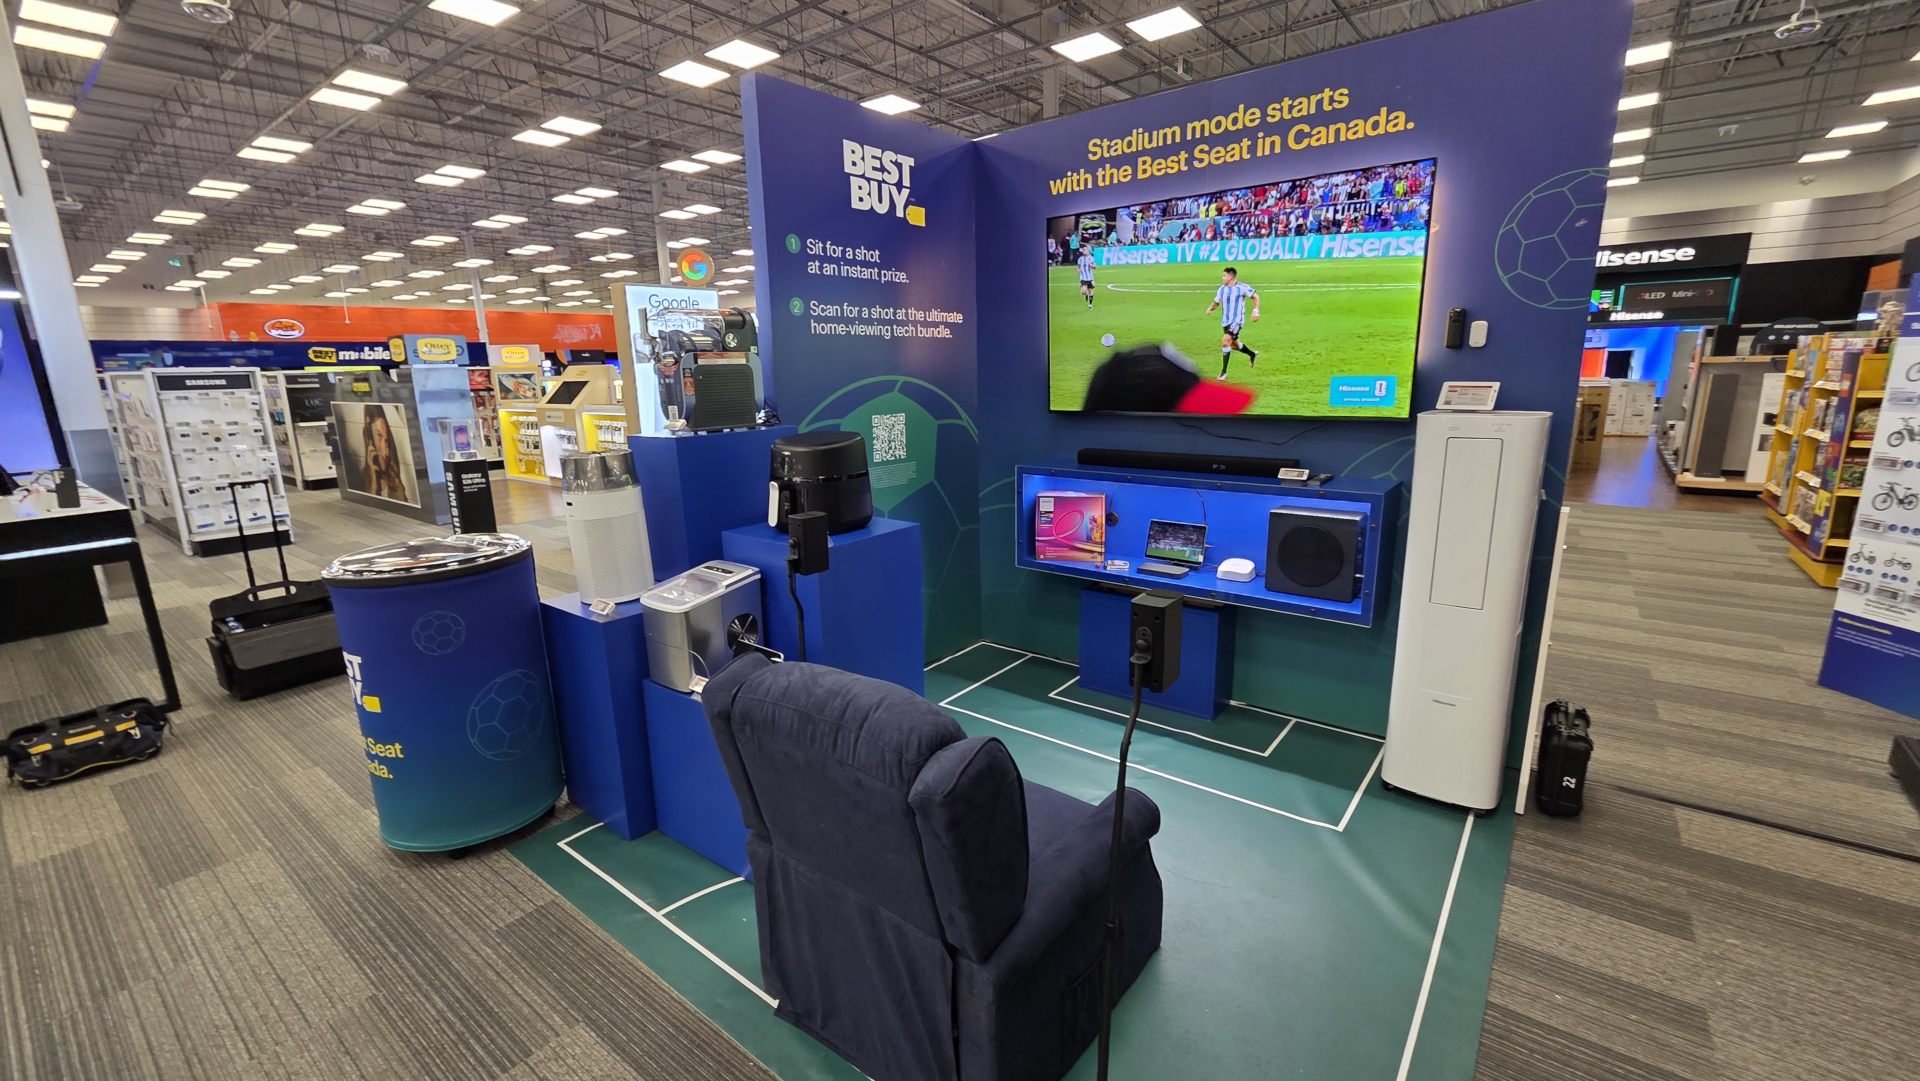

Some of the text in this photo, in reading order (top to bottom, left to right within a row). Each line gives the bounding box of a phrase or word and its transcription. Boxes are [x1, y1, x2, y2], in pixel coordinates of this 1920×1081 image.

[1087, 87, 1349, 161] Stadium mode starts
[1049, 106, 1415, 196] with the Best Seat in Canada.
[842, 139, 915, 187] BEST
[849, 176, 910, 218] BUY
[806, 239, 824, 255] Sit
[826, 241, 843, 258] for
[846, 247, 853, 259] a
[855, 245, 880, 263] shot
[1103, 231, 1425, 265] Hisense TV #2 GLOBALLY Hisense
[807, 261, 909, 284] at an instant prize.
[648, 294, 700, 309] Google
[810, 301, 841, 317] Scan
[843, 302, 859, 319] for
[862, 308, 869, 319] a
[870, 305, 894, 320] shot
[896, 306, 906, 320] at
[908, 307, 924, 322] the
[926, 308, 963, 324] ultimate
[1609, 311, 1665, 321] Hisense
[810, 319, 952, 339] home-viewing tech bundle.
[1338, 384, 1370, 392] Hisense
[446, 472, 462, 535] SAMSUN
[342, 651, 362, 681] ST
[367, 737, 404, 759] Seat
[368, 759, 394, 779] ada.
[1562, 776, 1577, 789] 22
